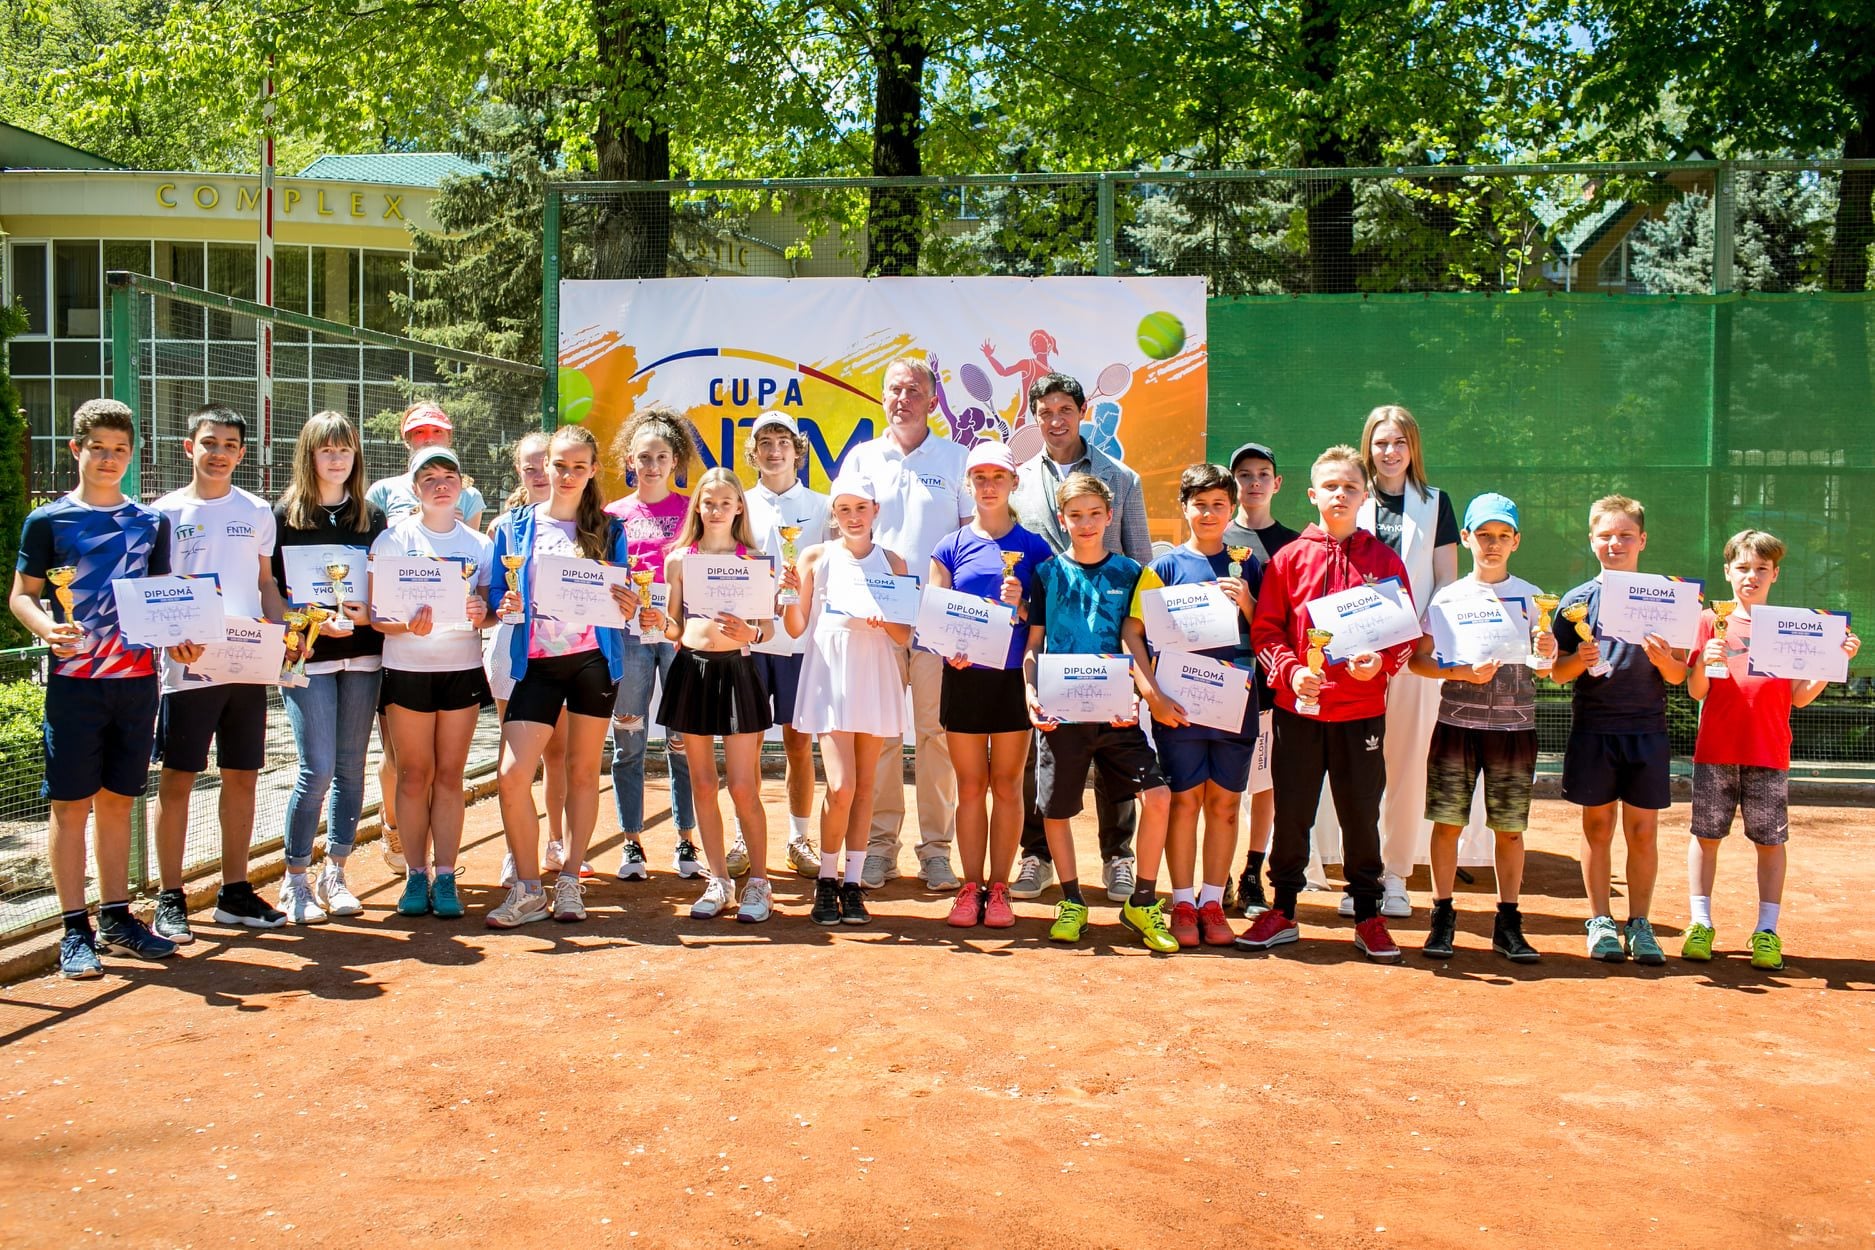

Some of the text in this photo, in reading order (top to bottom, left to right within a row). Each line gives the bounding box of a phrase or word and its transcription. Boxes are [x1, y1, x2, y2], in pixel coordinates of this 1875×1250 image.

[156, 183, 404, 220] COMPLEX
[709, 377, 803, 407] CUPA
[176, 527, 196, 540] ITF
[226, 526, 252, 534] FNTM
[399, 568, 441, 577] DIPLOMĂ
[562, 569, 605, 581] DIPLOMĂ
[707, 567, 749, 575] DIPLOMĂ
[144, 586, 193, 598] DIPLOMĂ
[313, 586, 354, 596] DIOMĂ
[1629, 586, 1676, 598] DIPLOMĂ
[1166, 593, 1209, 607] DIPLOMĂ
[1336, 593, 1380, 613] DIPLOMĂ
[947, 602, 989, 618] DIPLOMĂ
[1457, 609, 1502, 620] DIPLOMĂ
[1778, 621, 1824, 631] DIPLOMĂ
[1064, 665, 1108, 675] DIPLOMĂ
[1182, 665, 1225, 682] DIPLOMĂ
